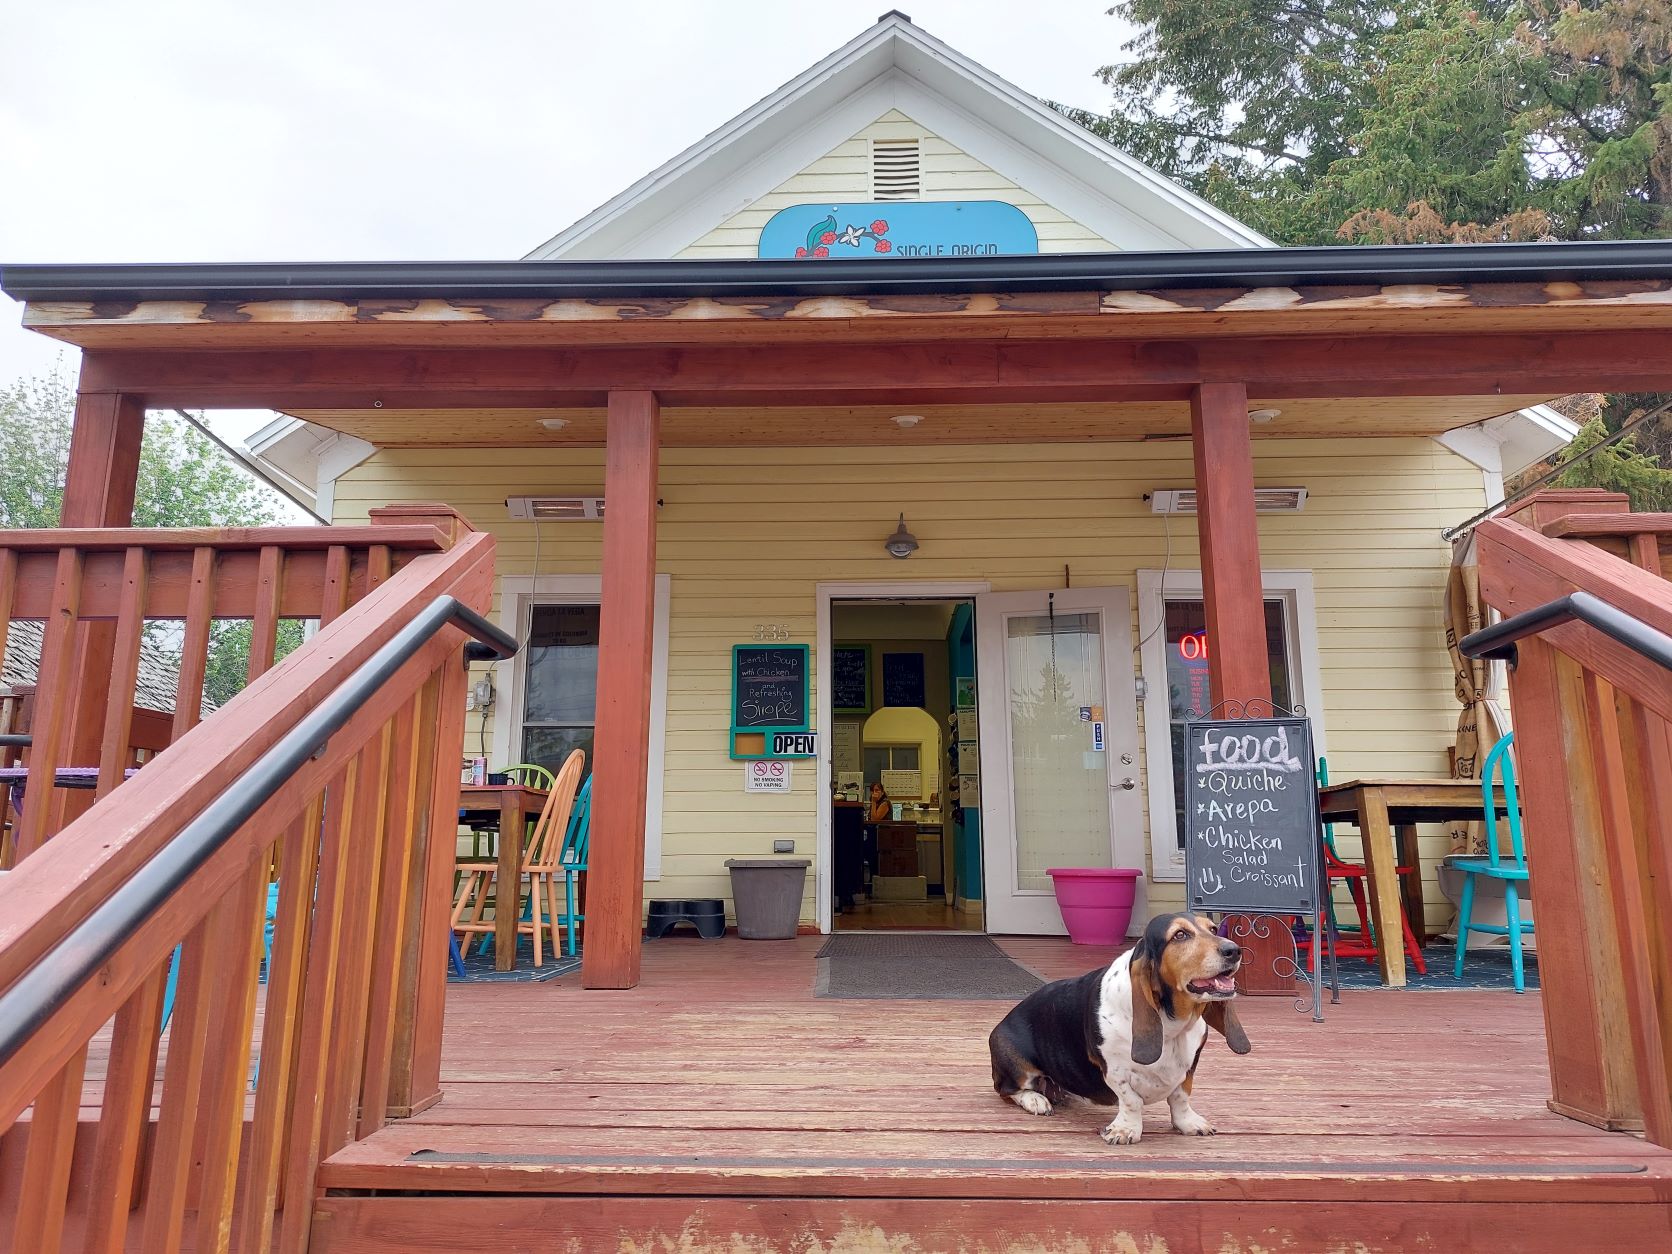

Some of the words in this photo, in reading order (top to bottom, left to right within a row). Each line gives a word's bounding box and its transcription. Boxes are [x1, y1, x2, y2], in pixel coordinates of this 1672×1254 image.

[897, 244, 944, 257] SINGLE
[952, 243, 997, 256] ORIGIN
[752, 624, 790, 641] 335
[773, 651, 798, 668] Soup
[741, 668, 754, 677] with
[756, 667, 790, 677] Chicken
[749, 686, 793, 702] Refreshing
[773, 735, 815, 754] OPEN
[1199, 726, 1298, 765] food
[1208, 768, 1287, 796] Quiche
[1208, 798, 1279, 824] Arepa
[1205, 825, 1283, 851] Chicken
[1222, 849, 1268, 866] Salad
[1230, 855, 1307, 888] Croissant
